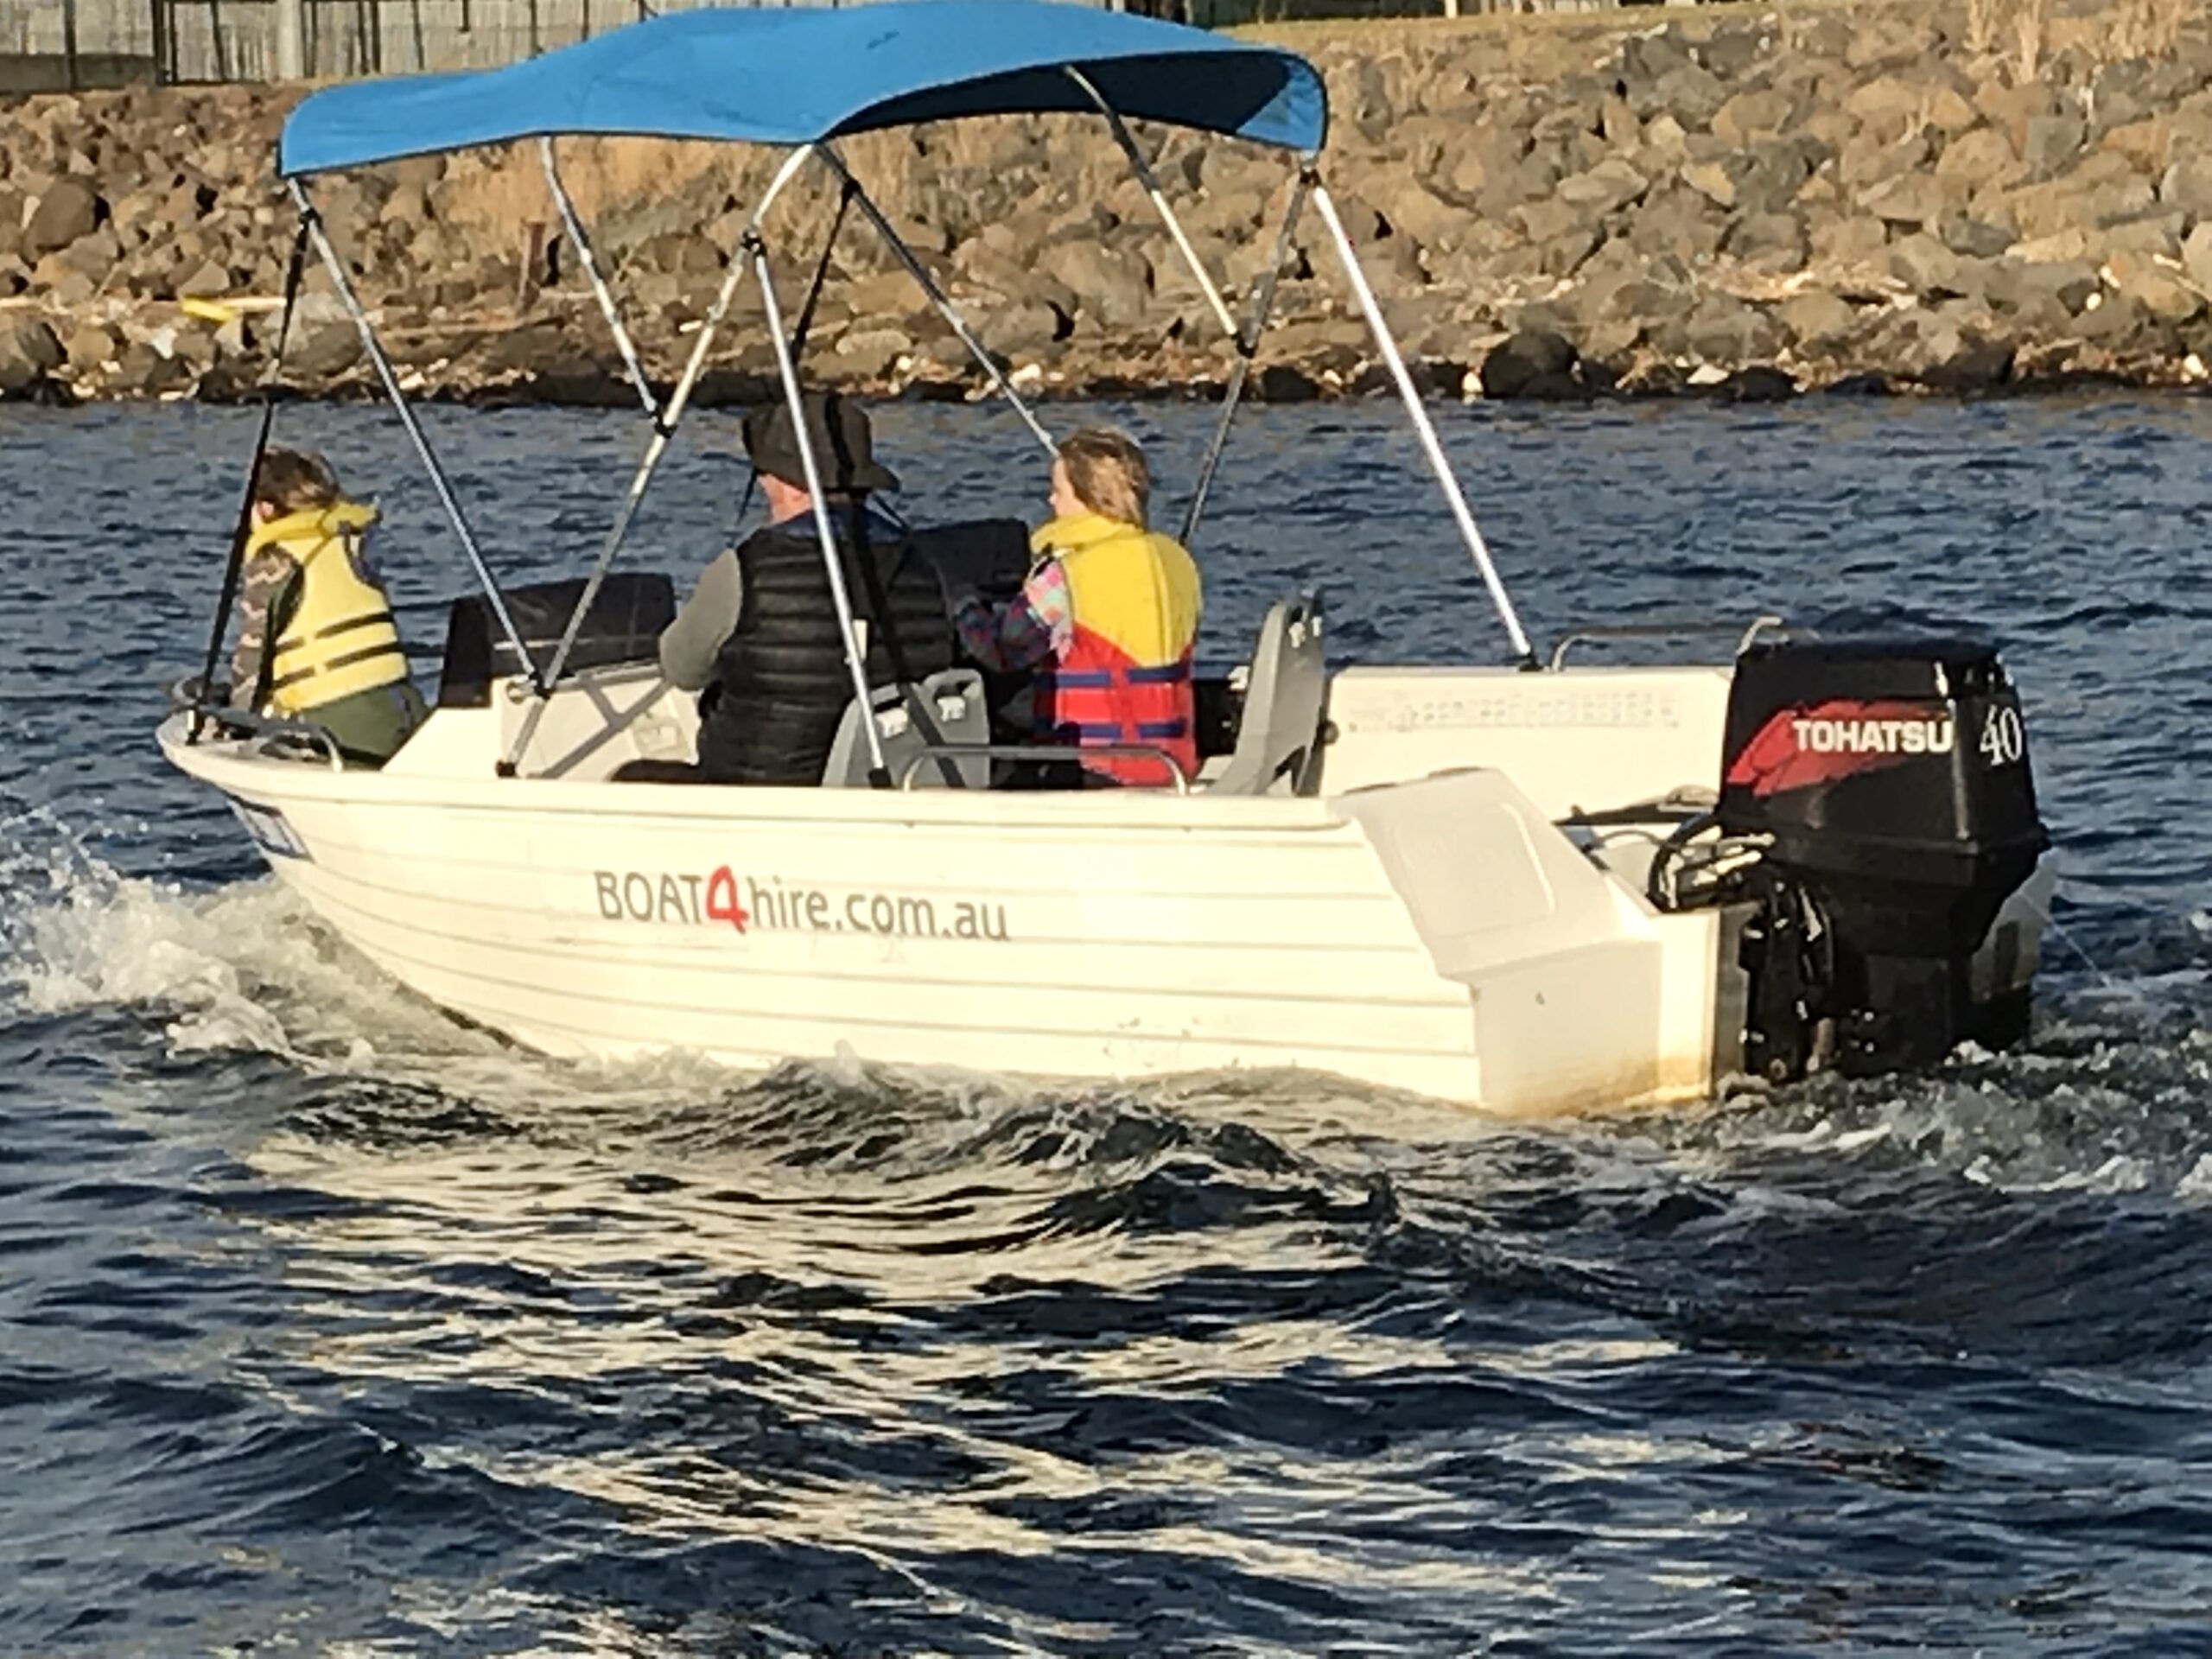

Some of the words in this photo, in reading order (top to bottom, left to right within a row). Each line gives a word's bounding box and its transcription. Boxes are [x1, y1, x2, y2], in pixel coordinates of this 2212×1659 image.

[1793, 720, 1955, 753] TOHATSU
[1980, 704, 2022, 766] 40
[594, 865, 1012, 942] BOAT4hire.com.au
